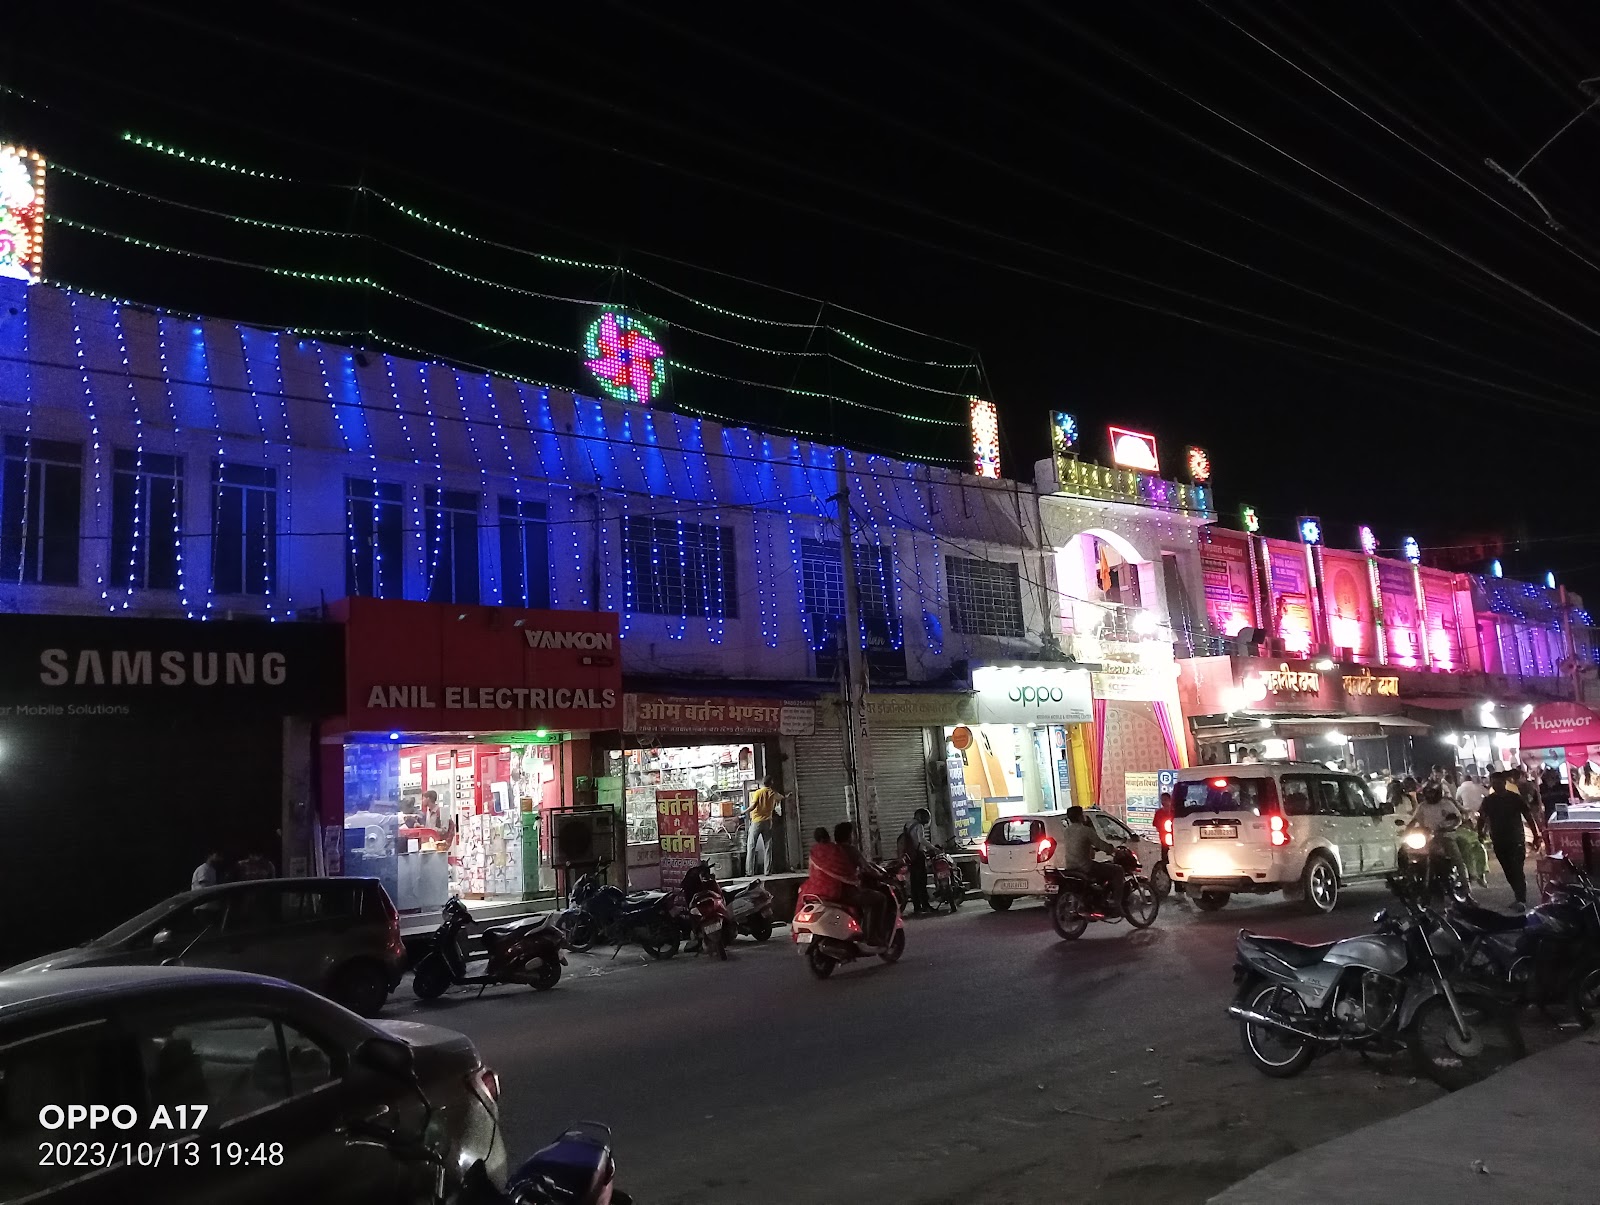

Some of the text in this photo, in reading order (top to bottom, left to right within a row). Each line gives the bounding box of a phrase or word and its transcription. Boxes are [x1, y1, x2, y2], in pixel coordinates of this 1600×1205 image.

[40, 648, 287, 686] SAMSUNG
[367, 685, 616, 710] ANIL ELECTRICALS
[1008, 686, 1063, 707] oppo
[16, 704, 64, 715] Mobile
[67, 704, 130, 715] Solutions
[639, 699, 680, 720] ओम
[684, 700, 725, 721] बर्तन
[728, 705, 779, 723] भण्डार
[1531, 715, 1593, 731] Havmor
[658, 792, 695, 816] बर्तन
[659, 829, 697, 853] बर्तन
